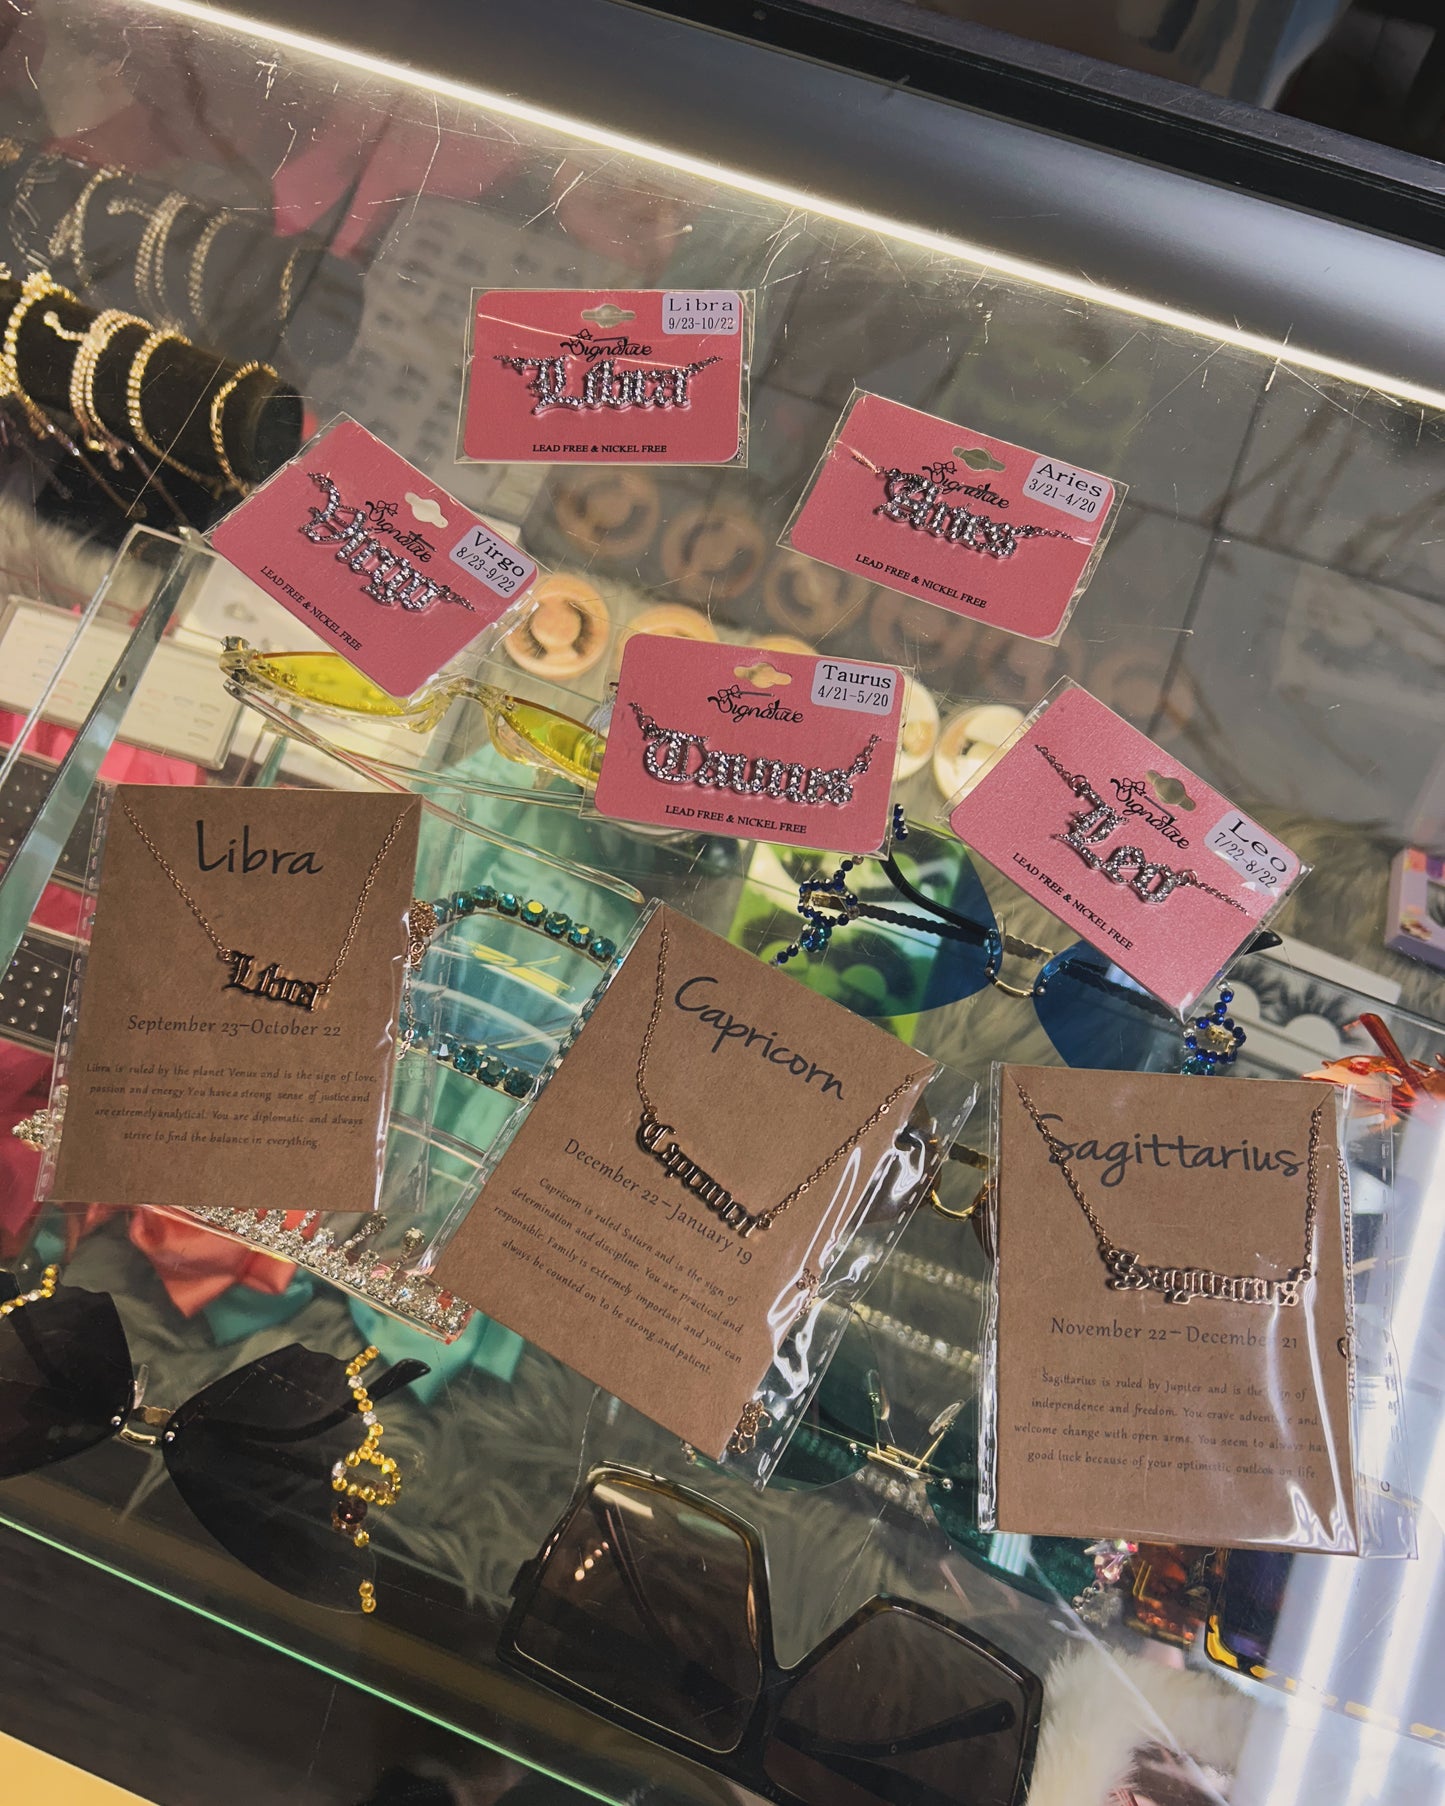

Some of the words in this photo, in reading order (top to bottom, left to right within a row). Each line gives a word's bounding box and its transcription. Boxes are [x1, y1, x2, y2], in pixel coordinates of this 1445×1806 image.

[669, 298, 733, 312] Libra
[668, 317, 734, 330] 9/23-10/22
[533, 444, 560, 453] LEAD
[563, 444, 589, 453] FREE
[591, 444, 599, 453] &
[601, 444, 640, 453] NICKEL
[641, 445, 667, 453] FREE
[1029, 479, 1096, 514] 3/21-4/20
[1036, 463, 1103, 497] Aries
[456, 547, 515, 593] 8/23-9/22
[474, 531, 525, 578] Virgo
[856, 554, 883, 571] LEAD
[885, 564, 910, 580] FREE
[911, 576, 920, 584] &
[921, 578, 958, 598] NICKEL
[961, 592, 987, 608] FREE
[260, 565, 284, 586] LEAD
[282, 583, 305, 603] FREE
[303, 600, 312, 609] &
[310, 606, 341, 636] NICKEL
[339, 630, 363, 651] FREE
[822, 664, 891, 689] Taurus
[818, 686, 889, 708] 4/21-5/20
[665, 805, 695, 817] LEAD
[697, 809, 724, 822] FREE
[726, 815, 735, 823] &
[737, 816, 778, 830] NICKEL
[780, 822, 807, 834] FREE
[196, 820, 325, 875] Libra
[1214, 832, 1277, 889] 7/22-8/22
[1228, 818, 1288, 875] Leo
[1012, 851, 1040, 877] LEAD
[1037, 872, 1064, 897] FREE
[1062, 893, 1072, 903] &
[1070, 899, 1107, 932] NICKEL
[1107, 927, 1134, 951] FREE
[127, 1014, 216, 1037] September
[322, 1024, 342, 1037] 22
[674, 976, 845, 1101] Capricorn
[86, 1063, 111, 1074] Libra
[115, 1064, 123, 1074] is
[129, 1064, 154, 1075] ruled
[158, 1064, 169, 1077] by
[174, 1065, 189, 1076] the
[193, 1066, 224, 1078] planet
[260, 1069, 280, 1079] and
[284, 1070, 292, 1080] is
[297, 1069, 312, 1080] the
[316, 1071, 336, 1083] sign
[341, 1071, 352, 1083] of
[90, 1084, 125, 1095] passion
[129, 1085, 149, 1095] and
[188, 1087, 206, 1097] You
[351, 1092, 370, 1103] and
[111, 1107, 157, 1120] extremely
[213, 1110, 229, 1121] You
[233, 1113, 249, 1122] are
[252, 1111, 304, 1124] diplomatic
[309, 1113, 328, 1124] and
[332, 1113, 364, 1127] always
[124, 1131, 152, 1141] strive
[155, 1130, 164, 1141] to
[165, 1130, 188, 1144] find
[191, 1131, 206, 1142] the
[209, 1132, 249, 1144] balance
[1037, 1113, 1304, 1187] Sagittarius
[564, 1138, 640, 1193] December
[736, 1246, 753, 1266] 19
[540, 1177, 581, 1209] Capricorn
[585, 1206, 594, 1216] is
[595, 1213, 621, 1232] ruled
[622, 1227, 653, 1252] Saturn
[655, 1249, 675, 1265] and
[675, 1261, 684, 1272] is
[687, 1268, 703, 1284] the
[704, 1281, 724, 1297] sign
[727, 1294, 740, 1307] of
[511, 1187, 572, 1229] determination
[575, 1226, 595, 1242] and
[595, 1238, 640, 1272] discipline.
[644, 1267, 661, 1284] You
[662, 1281, 679, 1295] are
[680, 1292, 722, 1321] practical
[722, 1318, 744, 1335] and
[502, 1239, 532, 1262] always
[532, 1255, 545, 1271] be
[546, 1266, 585, 1294] counted
[584, 1291, 597, 1302] on
[600, 1296, 610, 1311] to
[612, 1304, 624, 1320] be
[625, 1316, 656, 1342] strong
[657, 1336, 679, 1354] and
[547, 1236, 579, 1263] Family
[580, 1258, 588, 1268] is
[590, 1264, 633, 1297] extremely
[636, 1291, 682, 1326] important
[683, 1323, 704, 1340] and
[703, 1336, 723, 1352] you
[724, 1350, 742, 1364] can
[1051, 1317, 1142, 1339] November
[1281, 1337, 1297, 1349] 21
[1042, 1370, 1096, 1387] Sagittarius
[1102, 1377, 1111, 1387] is
[1116, 1377, 1142, 1388] ruled
[1148, 1378, 1161, 1391] by
[1164, 1381, 1201, 1394] Jupiter
[1208, 1383, 1227, 1394] and
[1233, 1385, 1241, 1395] is
[1295, 1387, 1307, 1401] of
[1031, 1396, 1104, 1413] independence
[1109, 1402, 1129, 1413] and
[1183, 1407, 1202, 1418] You
[1207, 1411, 1235, 1422] crave
[1297, 1416, 1318, 1426] and
[1014, 1422, 1058, 1436] welcome
[1062, 1424, 1100, 1440] change
[1104, 1428, 1127, 1440] with
[1131, 1431, 1158, 1444] open
[1198, 1435, 1217, 1447] You
[1221, 1438, 1249, 1448] seem
[1253, 1438, 1264, 1449] to
[1027, 1450, 1054, 1464] good
[1058, 1450, 1082, 1463] luck
[1085, 1452, 1128, 1467] because
[1132, 1454, 1145, 1470] of
[1147, 1459, 1172, 1472] your
